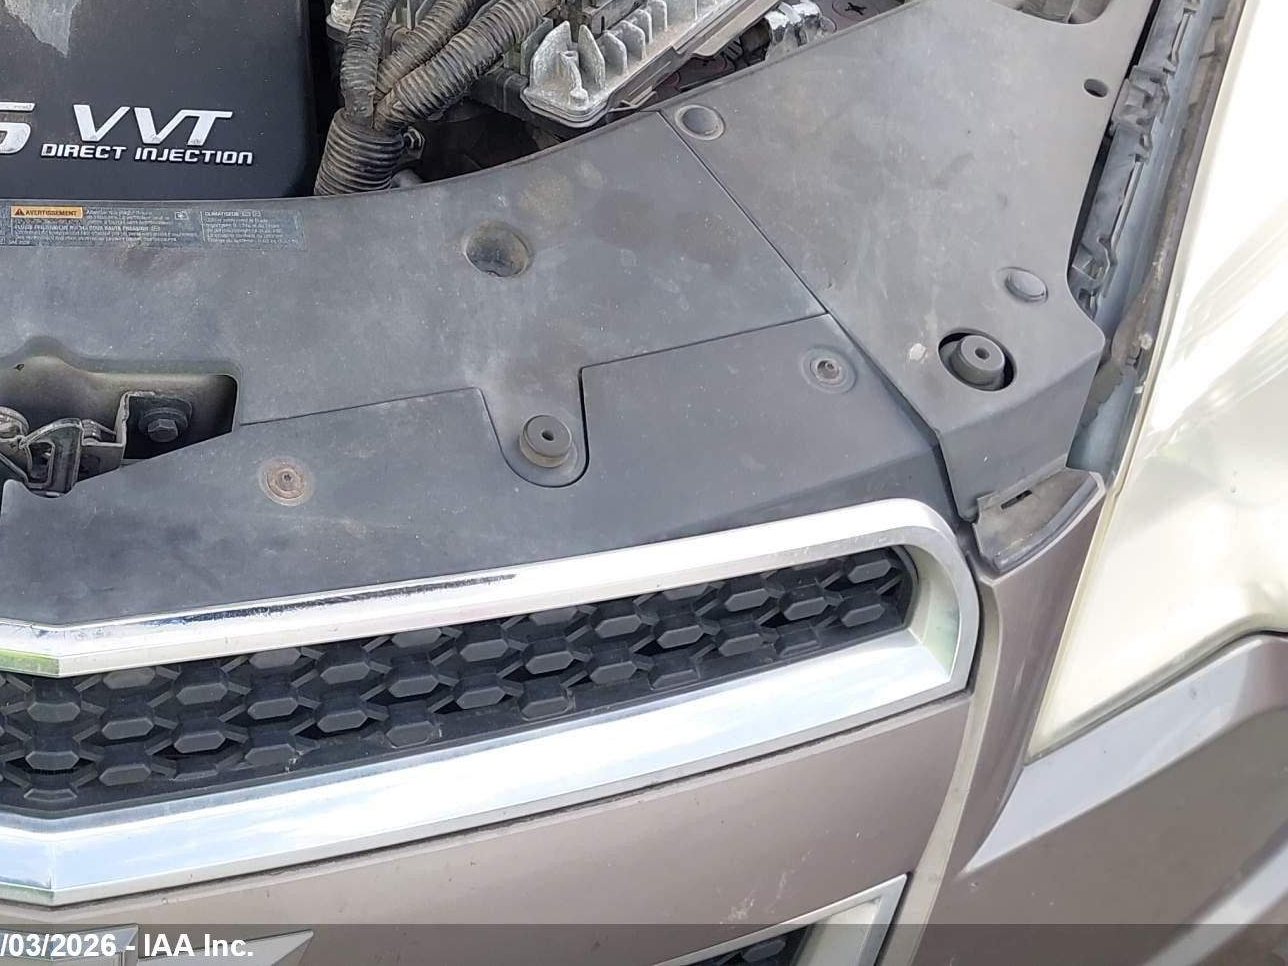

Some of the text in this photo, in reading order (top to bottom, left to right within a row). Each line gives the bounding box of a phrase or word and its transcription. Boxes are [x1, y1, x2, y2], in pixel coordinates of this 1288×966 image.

[73, 104, 233, 145] VVT
[41, 144, 253, 165] DIRECT INJECTION
